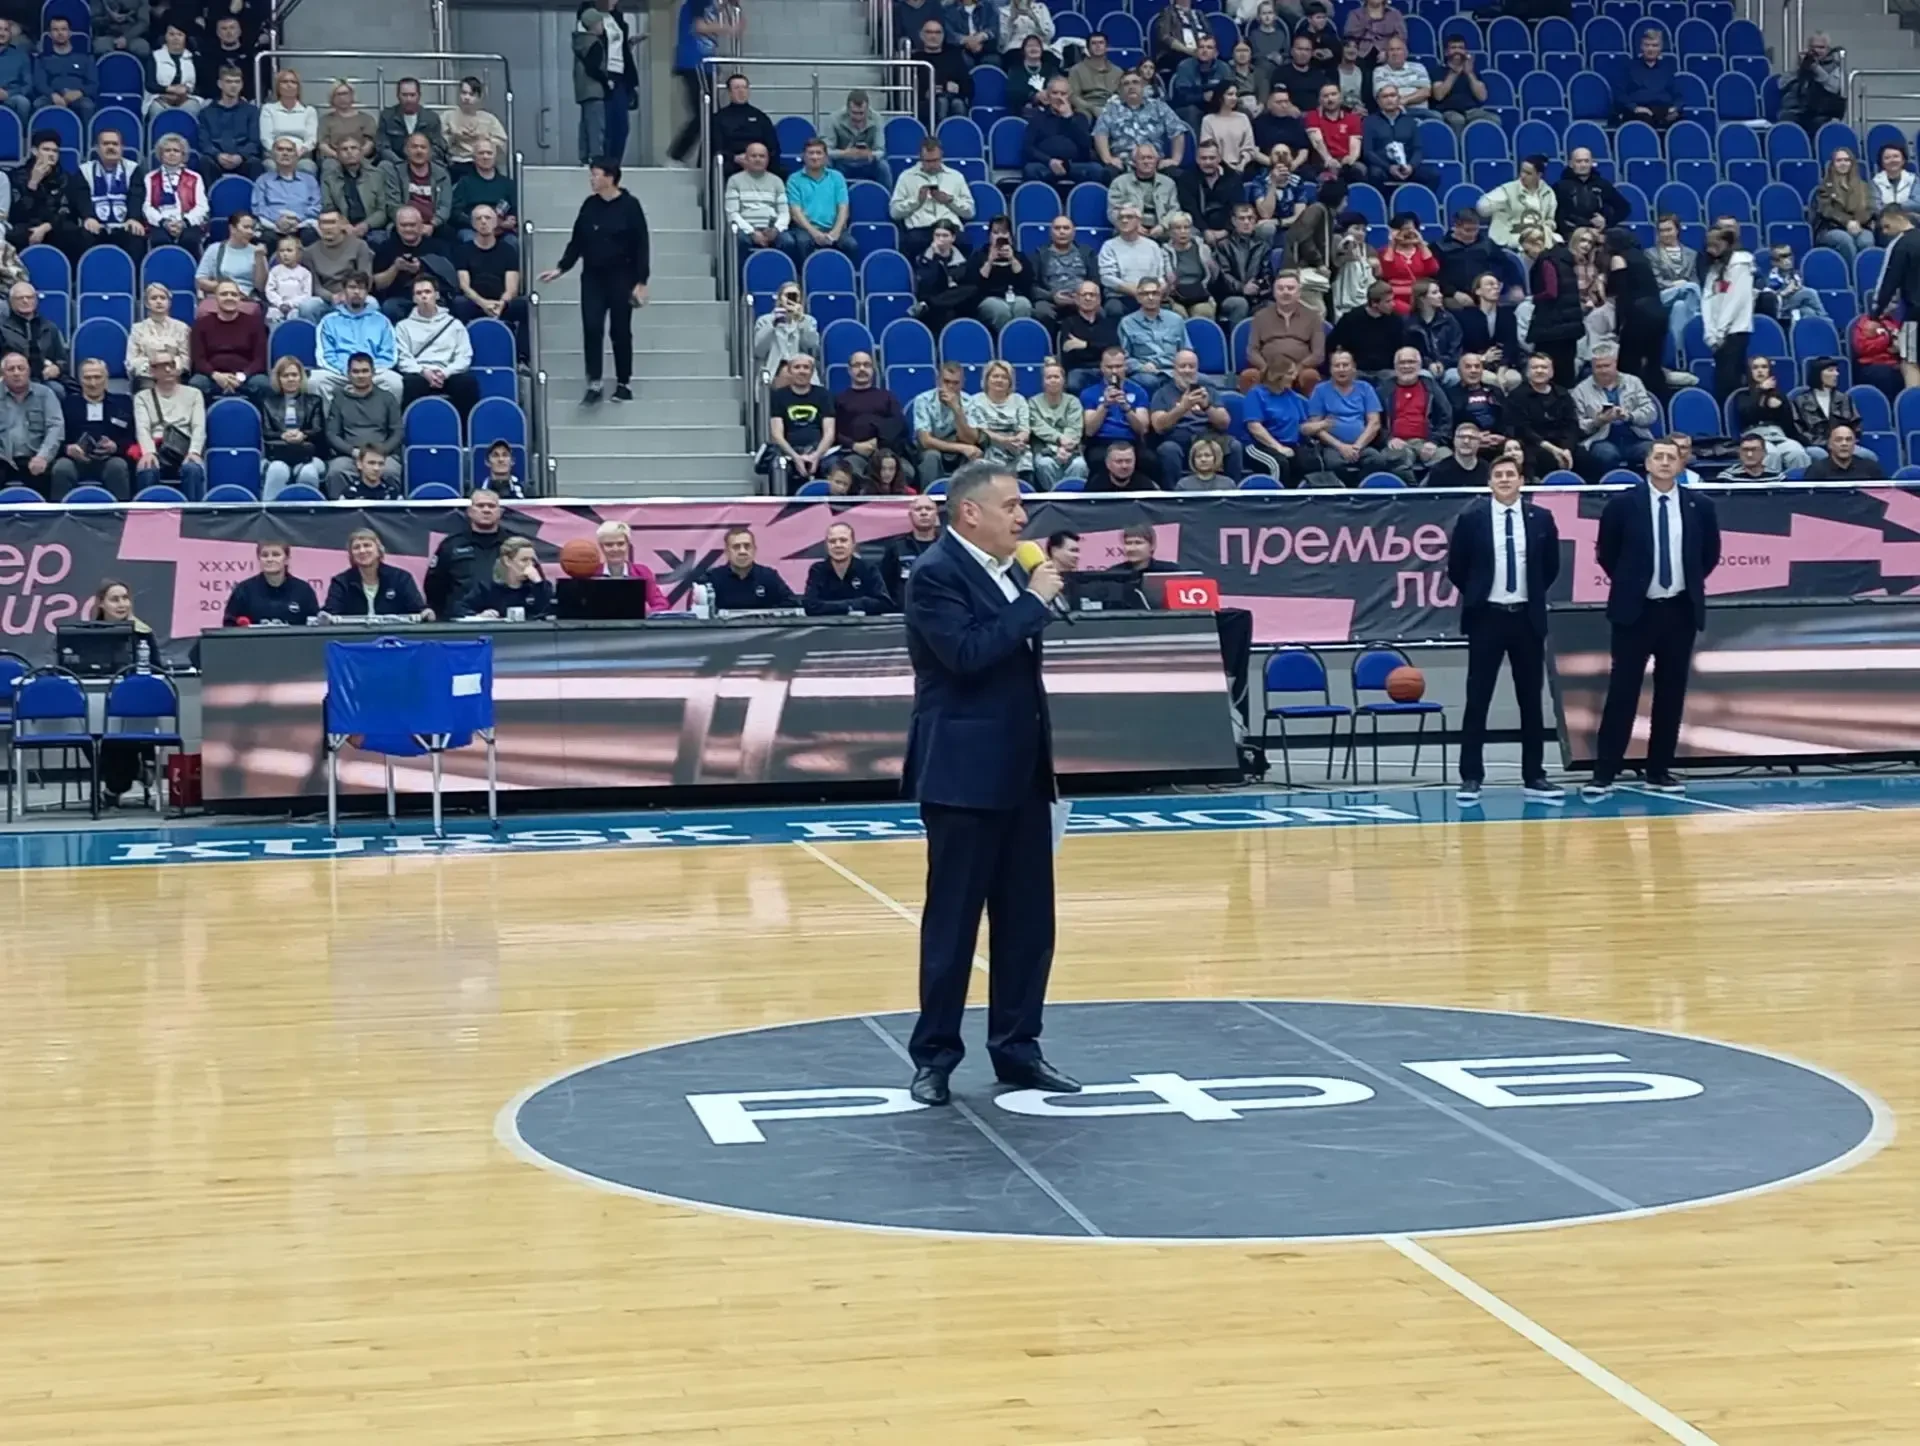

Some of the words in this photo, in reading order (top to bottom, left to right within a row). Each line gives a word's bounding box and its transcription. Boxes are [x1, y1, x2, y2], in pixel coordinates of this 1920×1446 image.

[1219, 524, 1448, 575] премье
[1719, 555, 1770, 566] ОССИИ
[1179, 588, 1208, 604] 5
[110, 825, 751, 860] KURSK
